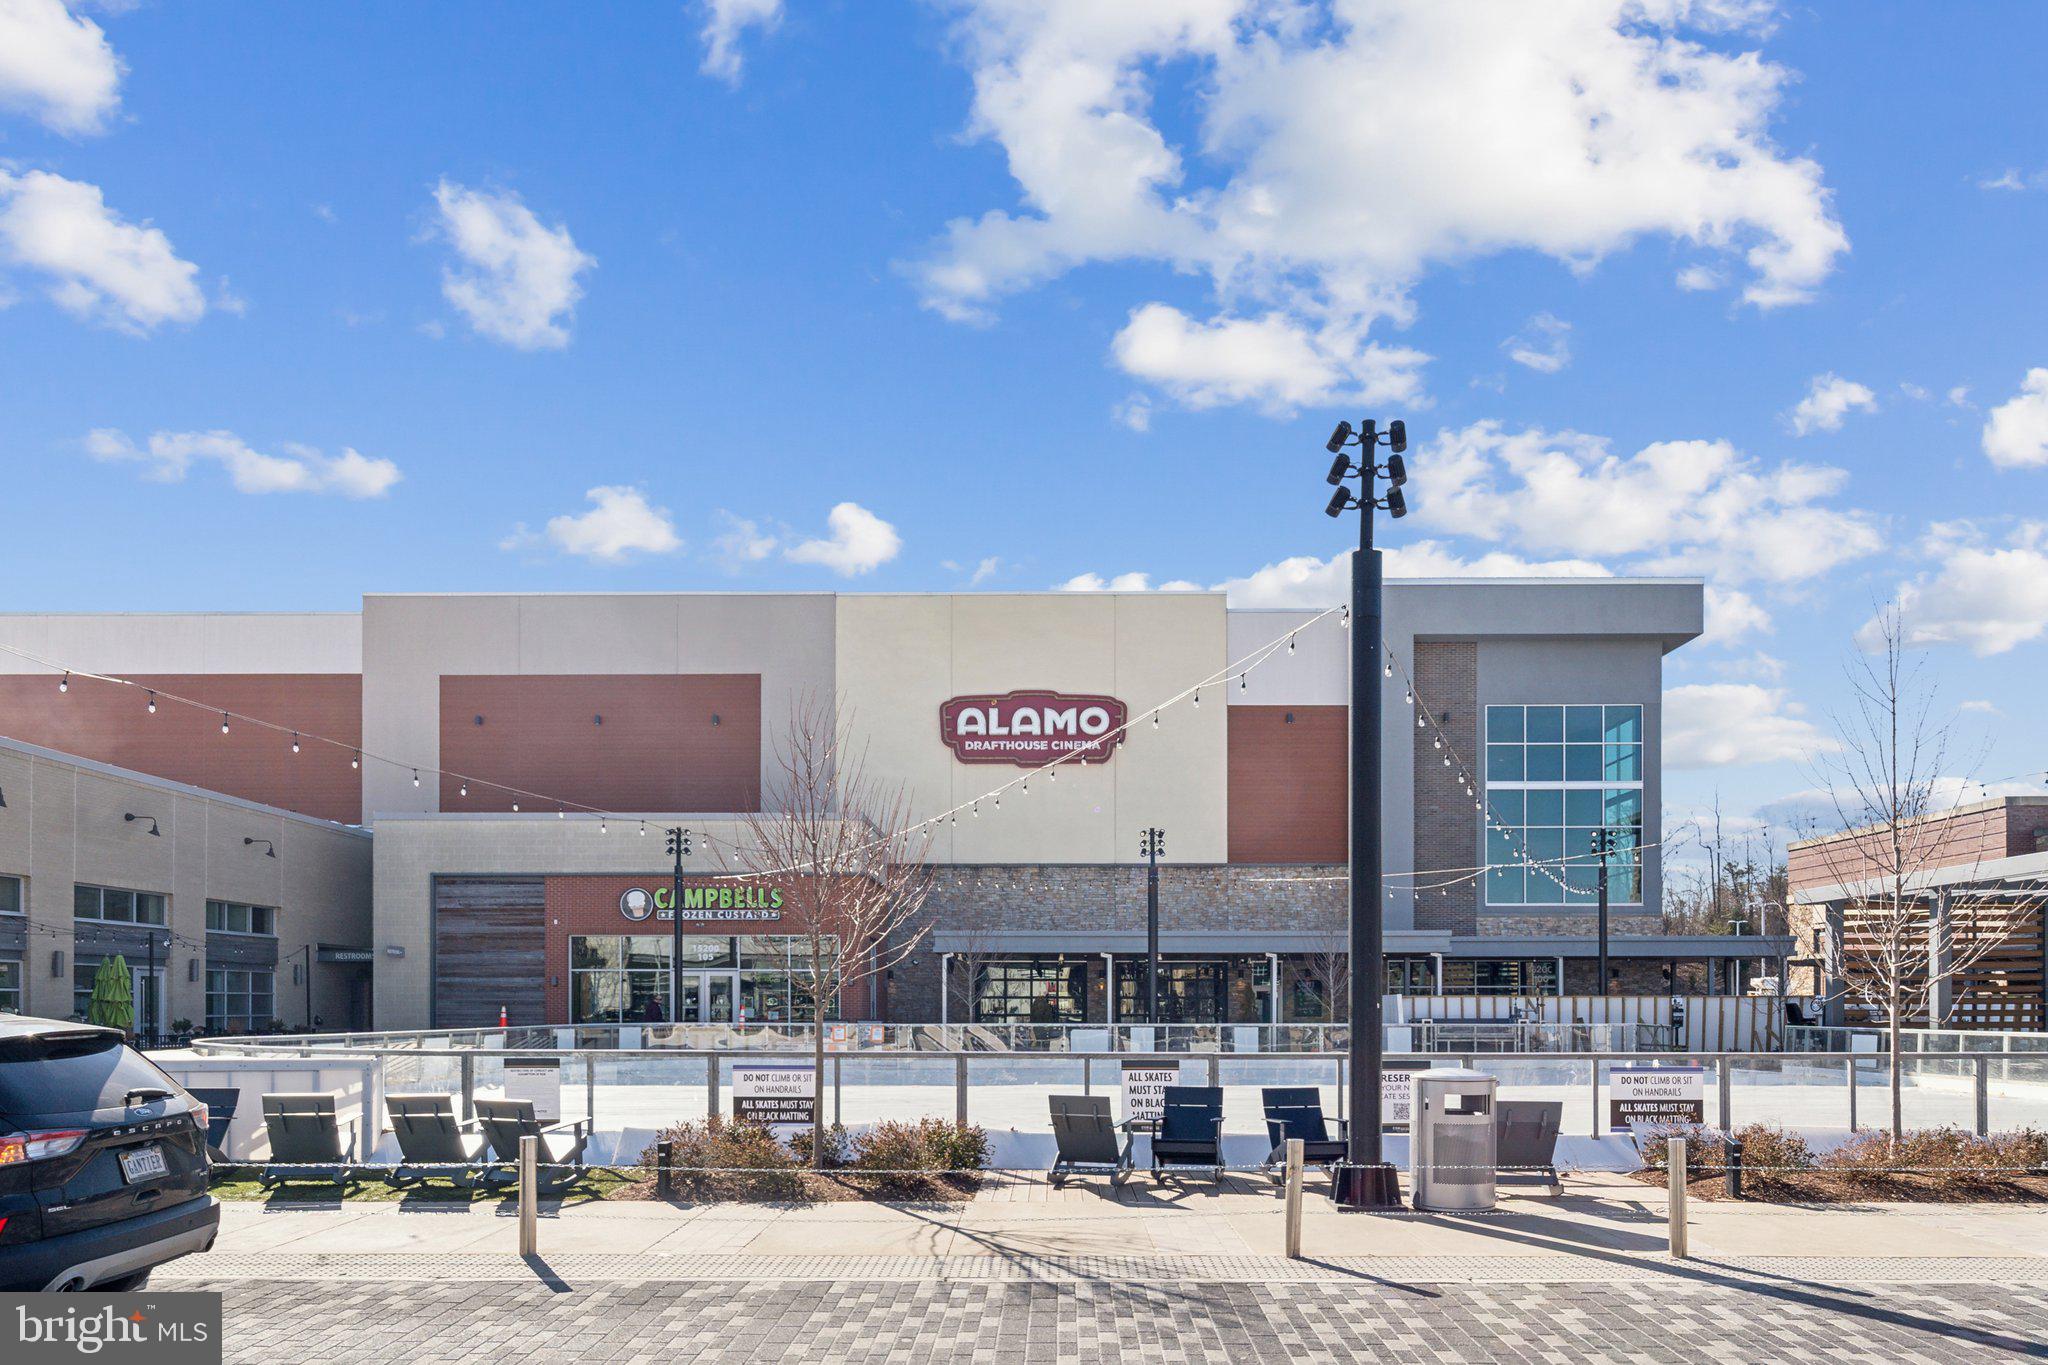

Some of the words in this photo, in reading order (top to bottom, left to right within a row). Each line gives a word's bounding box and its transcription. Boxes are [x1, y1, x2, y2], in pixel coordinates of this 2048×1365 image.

[956, 706, 1110, 736] ALAMO
[964, 740, 1048, 751] DRAFTHOUSE
[1051, 740, 1101, 751] CINEMA
[668, 910, 713, 919] FOZEN
[698, 953, 714, 961] 105
[743, 1074, 754, 1082] DO
[755, 1074, 769, 1082] NOT
[771, 1074, 790, 1082] CLIMB
[792, 1074, 802, 1082] OR
[803, 1074, 813, 1082] SIT
[1128, 1072, 1143, 1082] ALL
[1144, 1072, 1172, 1082] SKATES
[1621, 1076, 1632, 1085] DO
[1634, 1076, 1648, 1085] NOT
[1650, 1076, 1670, 1085] CLIMB
[1672, 1076, 1682, 1085] OR
[1683, 1076, 1693, 1085] SIT
[754, 1085, 764, 1094] ON
[766, 1085, 802, 1094] HANDRAILS
[1128, 1085, 1152, 1095] MUST
[1153, 1085, 1168, 1095] STA
[1632, 1088, 1643, 1096] ON
[1644, 1088, 1682, 1096] HANDRAILS
[742, 1100, 754, 1109] ALL
[755, 1100, 779, 1109] SKATES
[780, 1100, 798, 1109] MUST
[799, 1100, 814, 1109] STAY
[1130, 1098, 1143, 1108] ON
[1620, 1103, 1632, 1112] ALL
[1634, 1103, 1658, 1112] SKATES
[1660, 1103, 1678, 1112] MUST
[1680, 1103, 1695, 1112] STAY
[780, 1112, 809, 1120] MATTING
[1625, 1115, 1636, 1124] ON
[1637, 1115, 1658, 1124] BLACK
